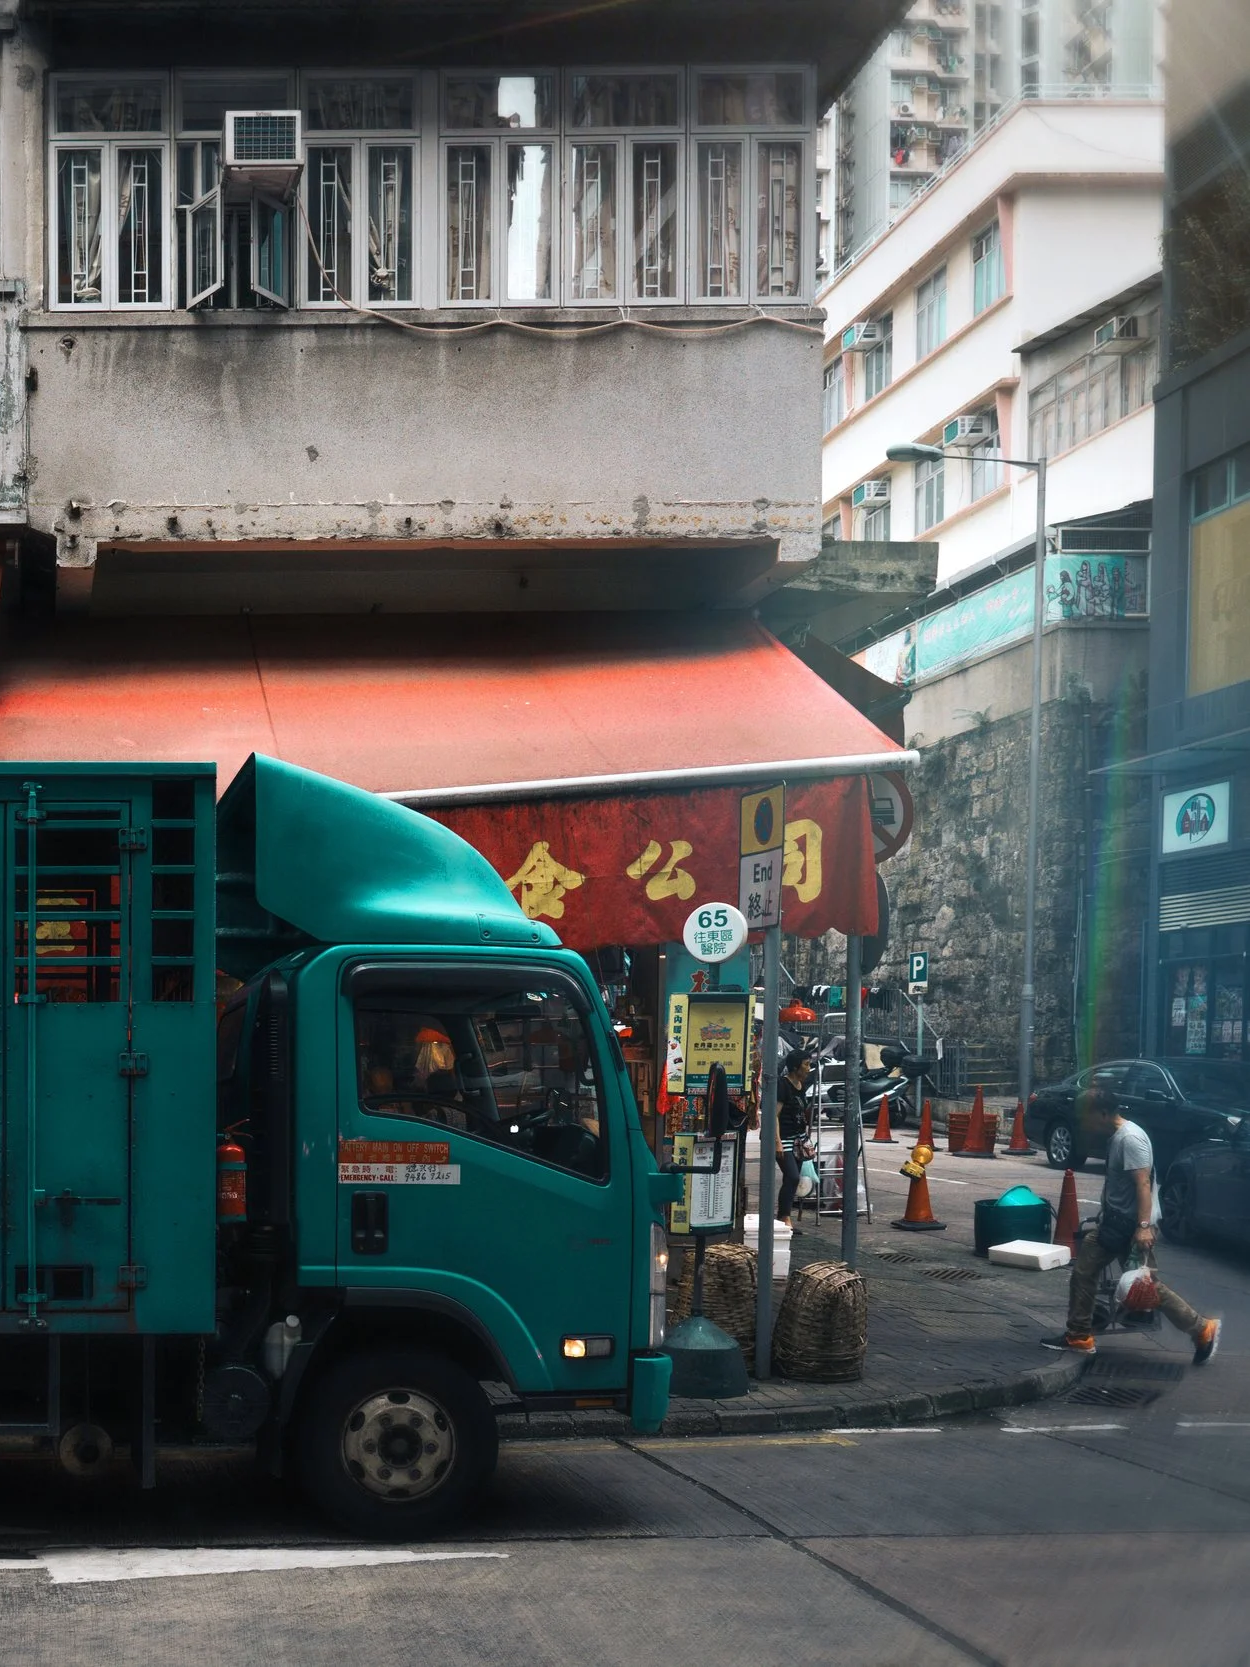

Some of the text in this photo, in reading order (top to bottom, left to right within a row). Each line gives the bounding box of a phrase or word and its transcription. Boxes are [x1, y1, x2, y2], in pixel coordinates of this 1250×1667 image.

[753, 860, 773, 883] End
[747, 890, 773, 920] 終止
[698, 909, 728, 928] 65
[693, 929, 734, 944] 往東區
[700, 942, 727, 956] 醫院
[913, 956, 925, 979] P
[393, 1143, 403, 1153] ON
[407, 1143, 420, 1153] OFF
[423, 1144, 449, 1153] SWITCH
